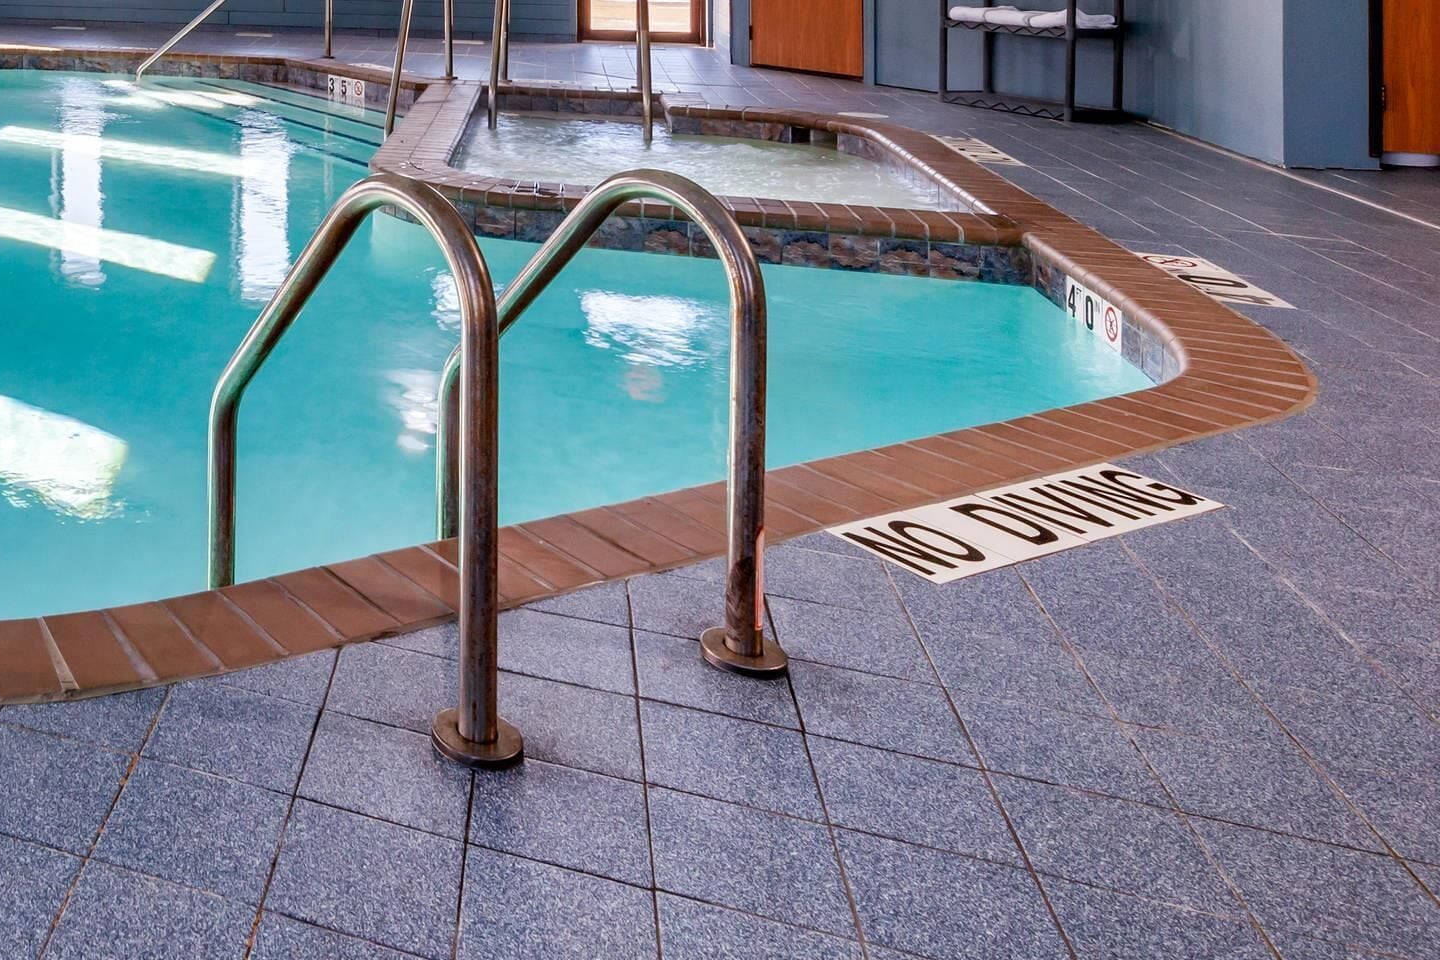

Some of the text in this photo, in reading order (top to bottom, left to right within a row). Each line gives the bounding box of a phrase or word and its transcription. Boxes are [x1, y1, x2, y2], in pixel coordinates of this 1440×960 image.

[329, 78, 347, 95] 3 5
[1068, 284, 1076, 318] 4
[1086, 295, 1094, 331] 0
[843, 469, 1205, 576] NO DIVING
